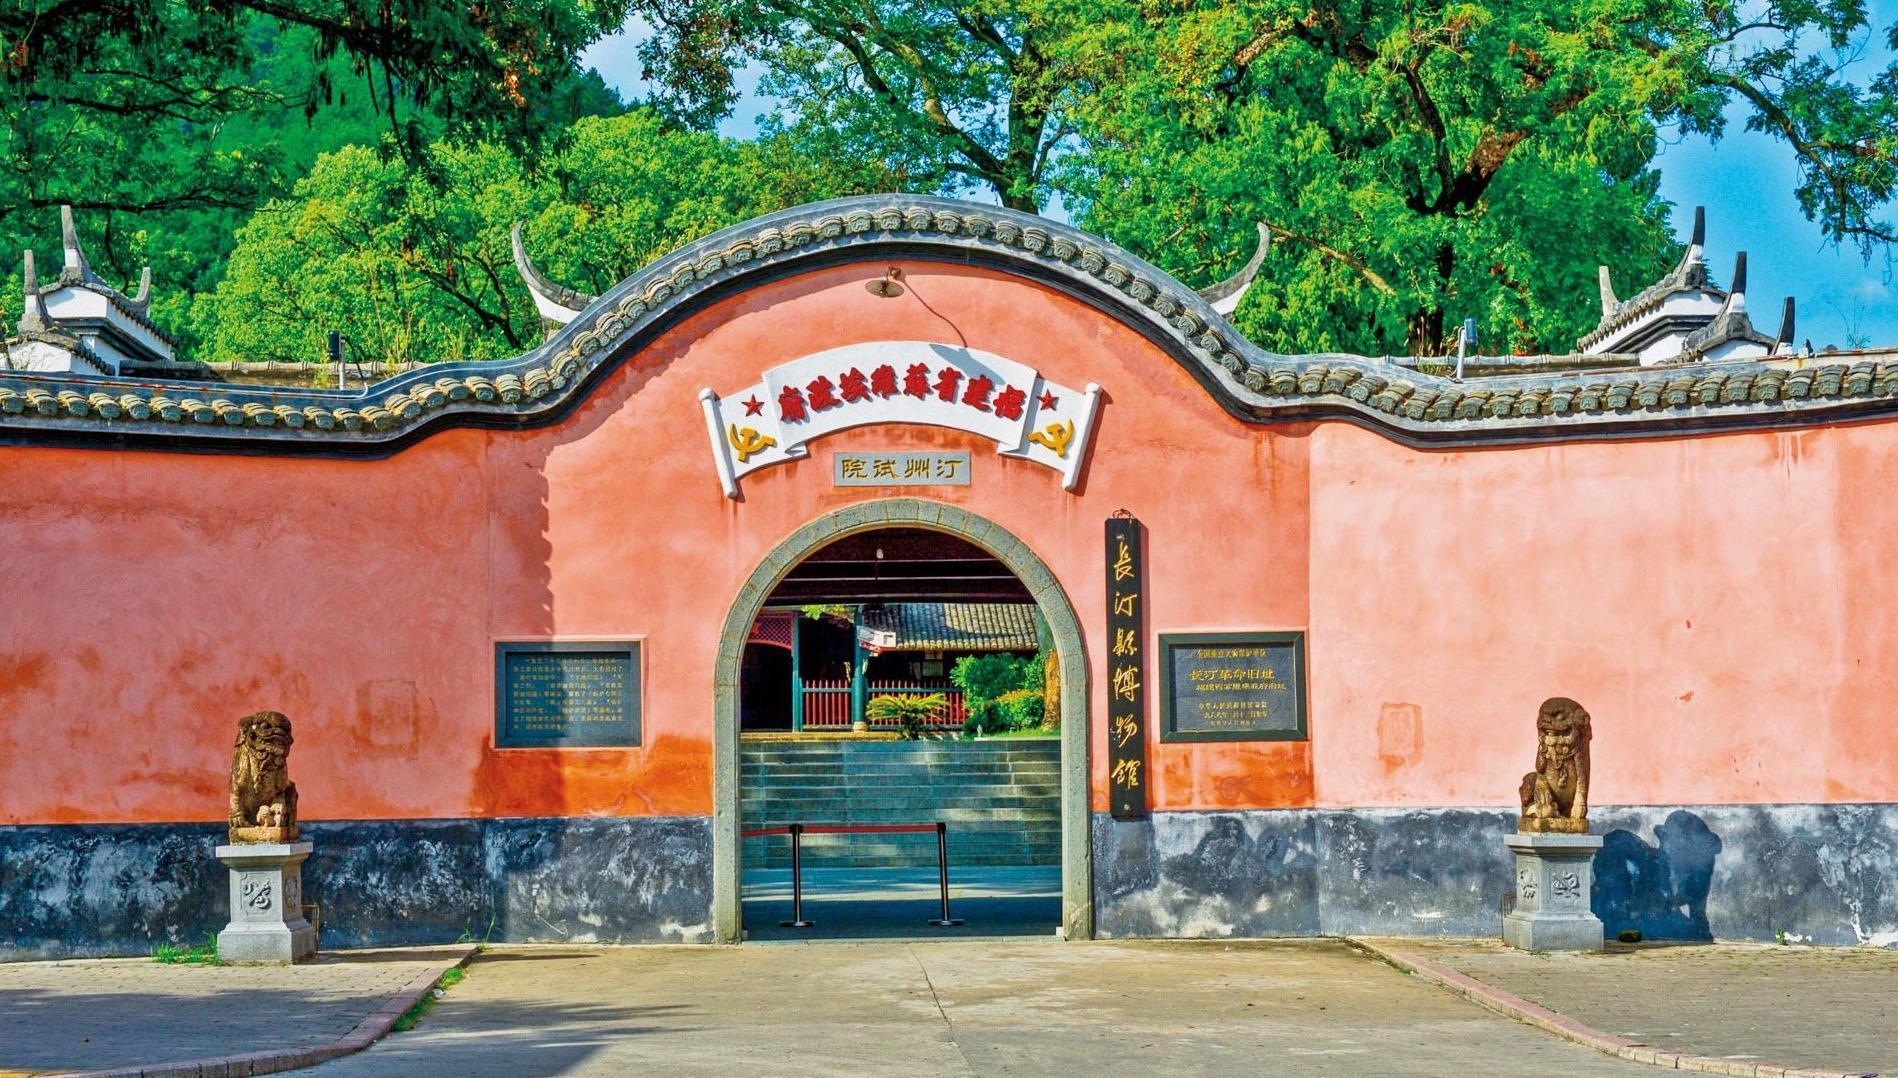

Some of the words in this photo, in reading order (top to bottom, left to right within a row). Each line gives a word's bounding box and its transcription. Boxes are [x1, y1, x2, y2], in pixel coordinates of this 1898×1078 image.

[1189, 668, 1276, 681] 长汀革命旧址
